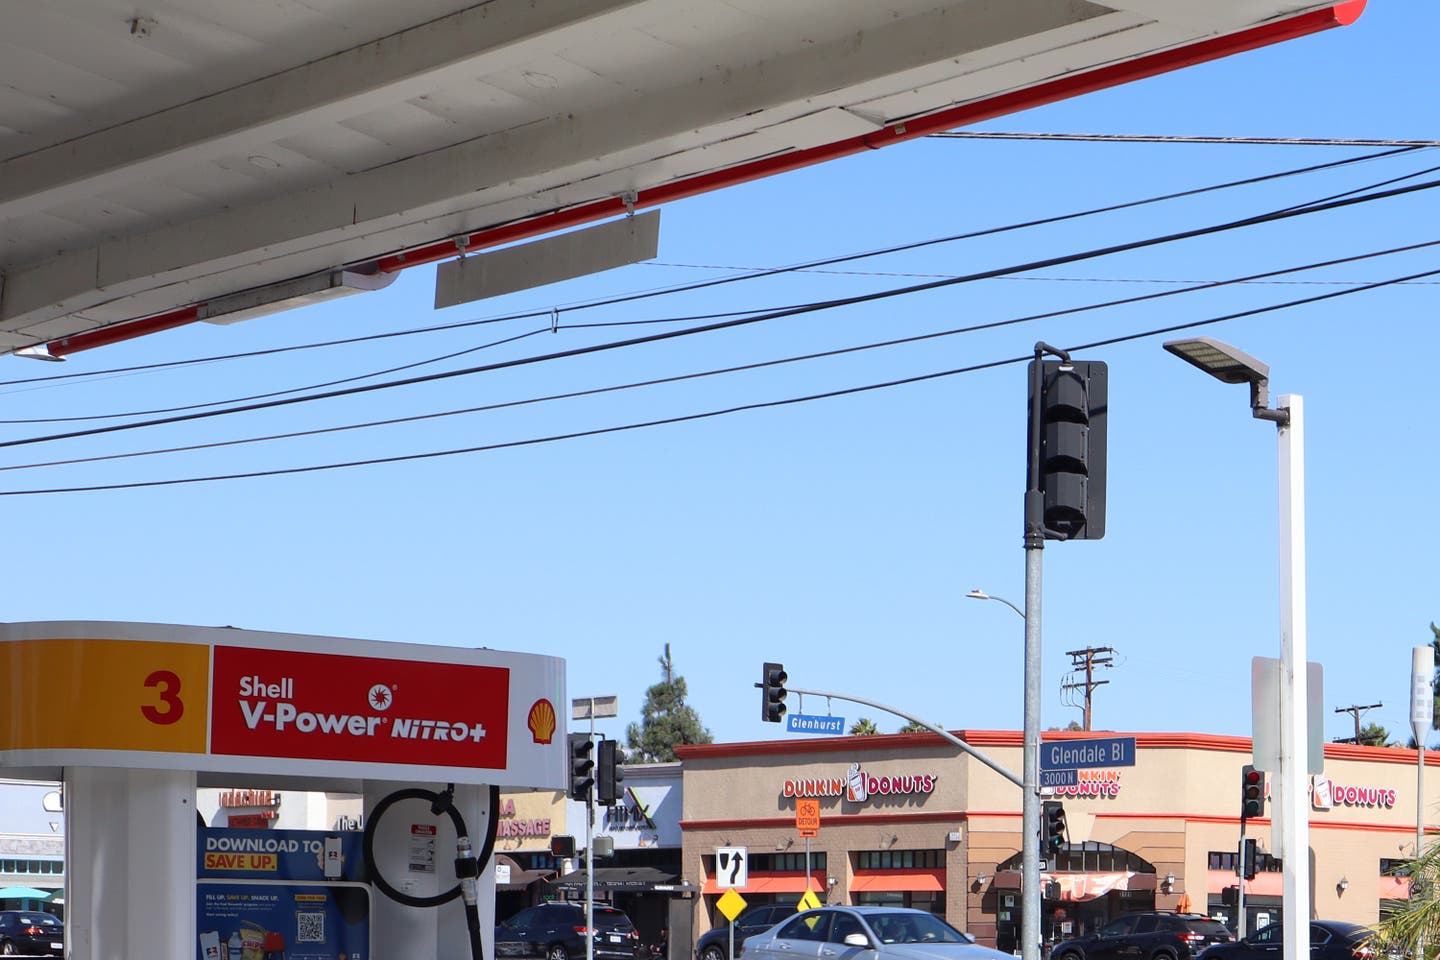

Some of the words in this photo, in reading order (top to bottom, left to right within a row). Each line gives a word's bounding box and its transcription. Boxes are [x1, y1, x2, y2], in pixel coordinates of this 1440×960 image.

[239, 676, 294, 700] Shell
[141, 670, 184, 725] 3
[239, 700, 381, 737] V-Power
[791, 717, 841, 731] Glenhurst
[1051, 744, 1106, 765] Glendale
[1112, 743, 1124, 761] Bl
[868, 774, 936, 795] DONUTS
[1044, 772, 1067, 785] 3000
[1067, 772, 1074, 783] N
[1335, 786, 1396, 805] DONUTS
[337, 815, 355, 831] The
[798, 818, 818, 826] DETOUR
[206, 837, 299, 853] DOWNLOAD
[303, 840, 323, 853] TO
[206, 855, 244, 869] SAVE
[251, 855, 276, 869] UP.
